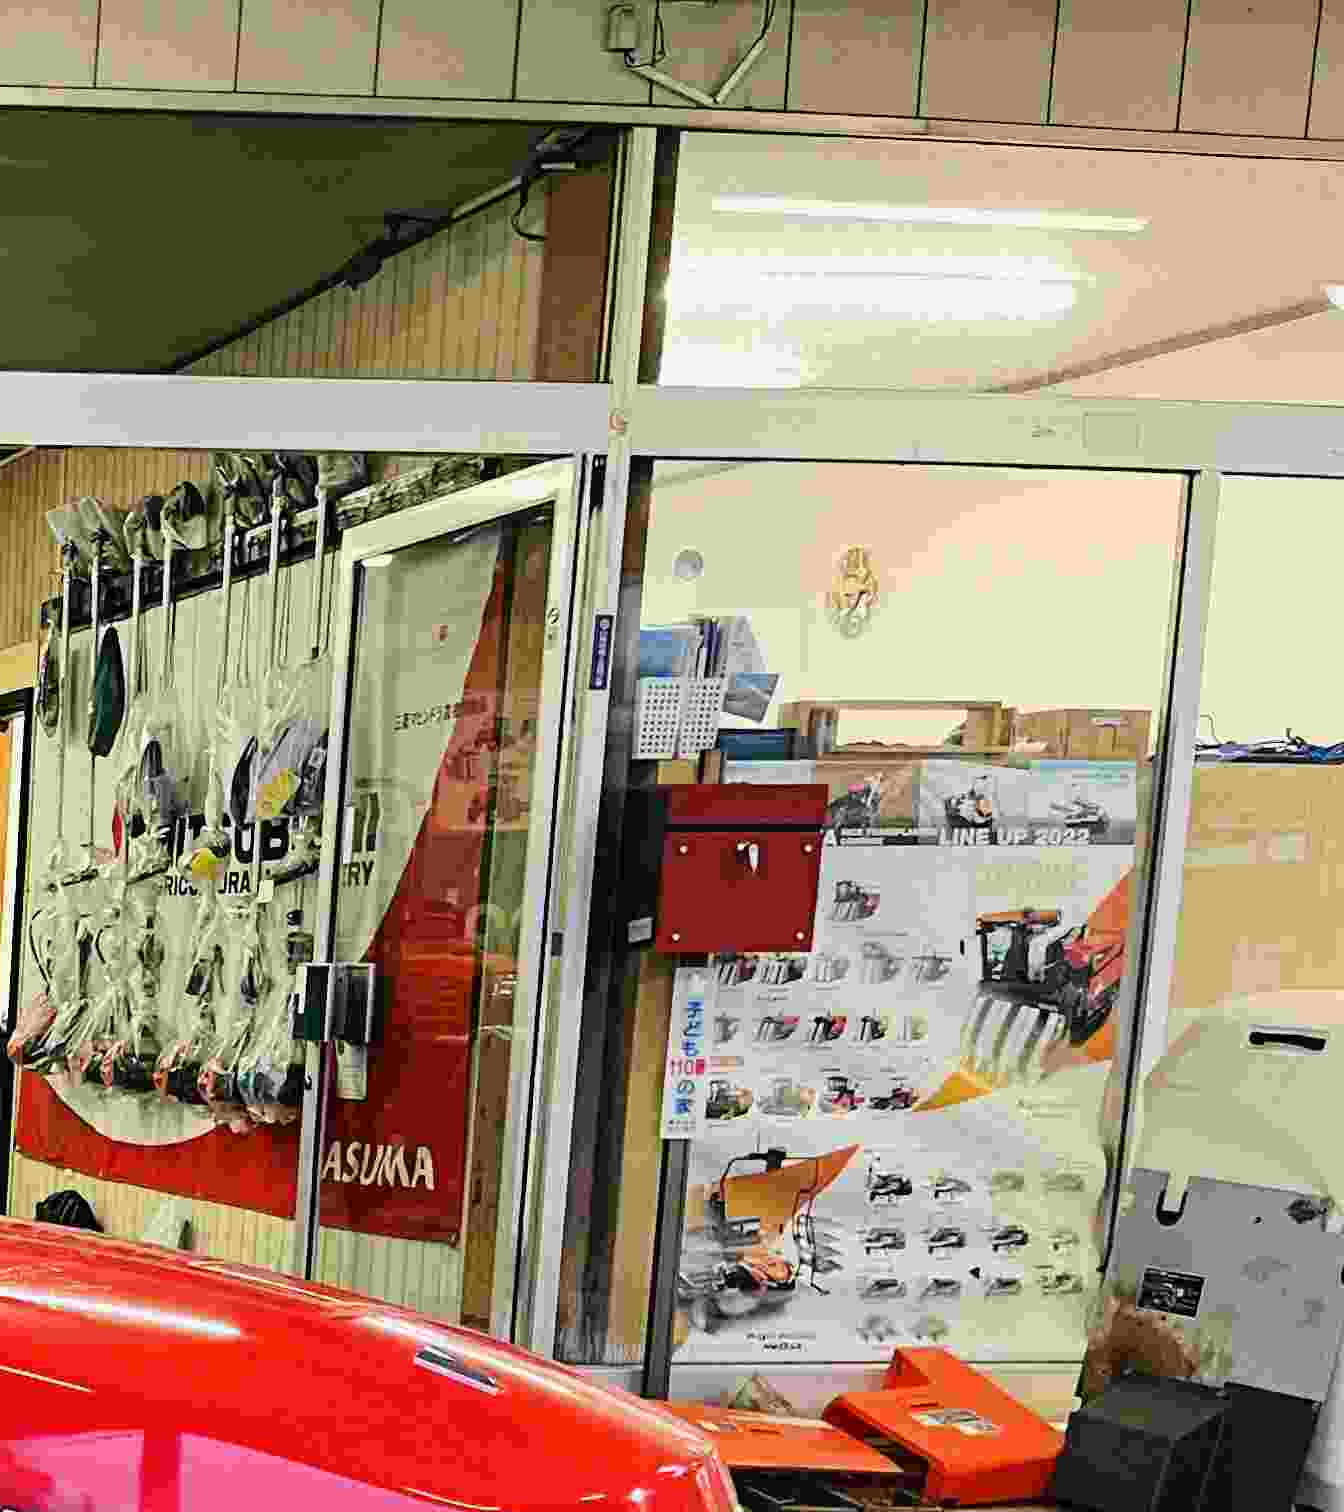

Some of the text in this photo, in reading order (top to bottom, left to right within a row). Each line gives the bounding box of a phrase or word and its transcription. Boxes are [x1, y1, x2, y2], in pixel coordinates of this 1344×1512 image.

[937, 828, 992, 846] LINE
[996, 828, 1030, 846] UP
[1033, 828, 1091, 846] 2022
[321, 1140, 435, 1191] ASUMA
